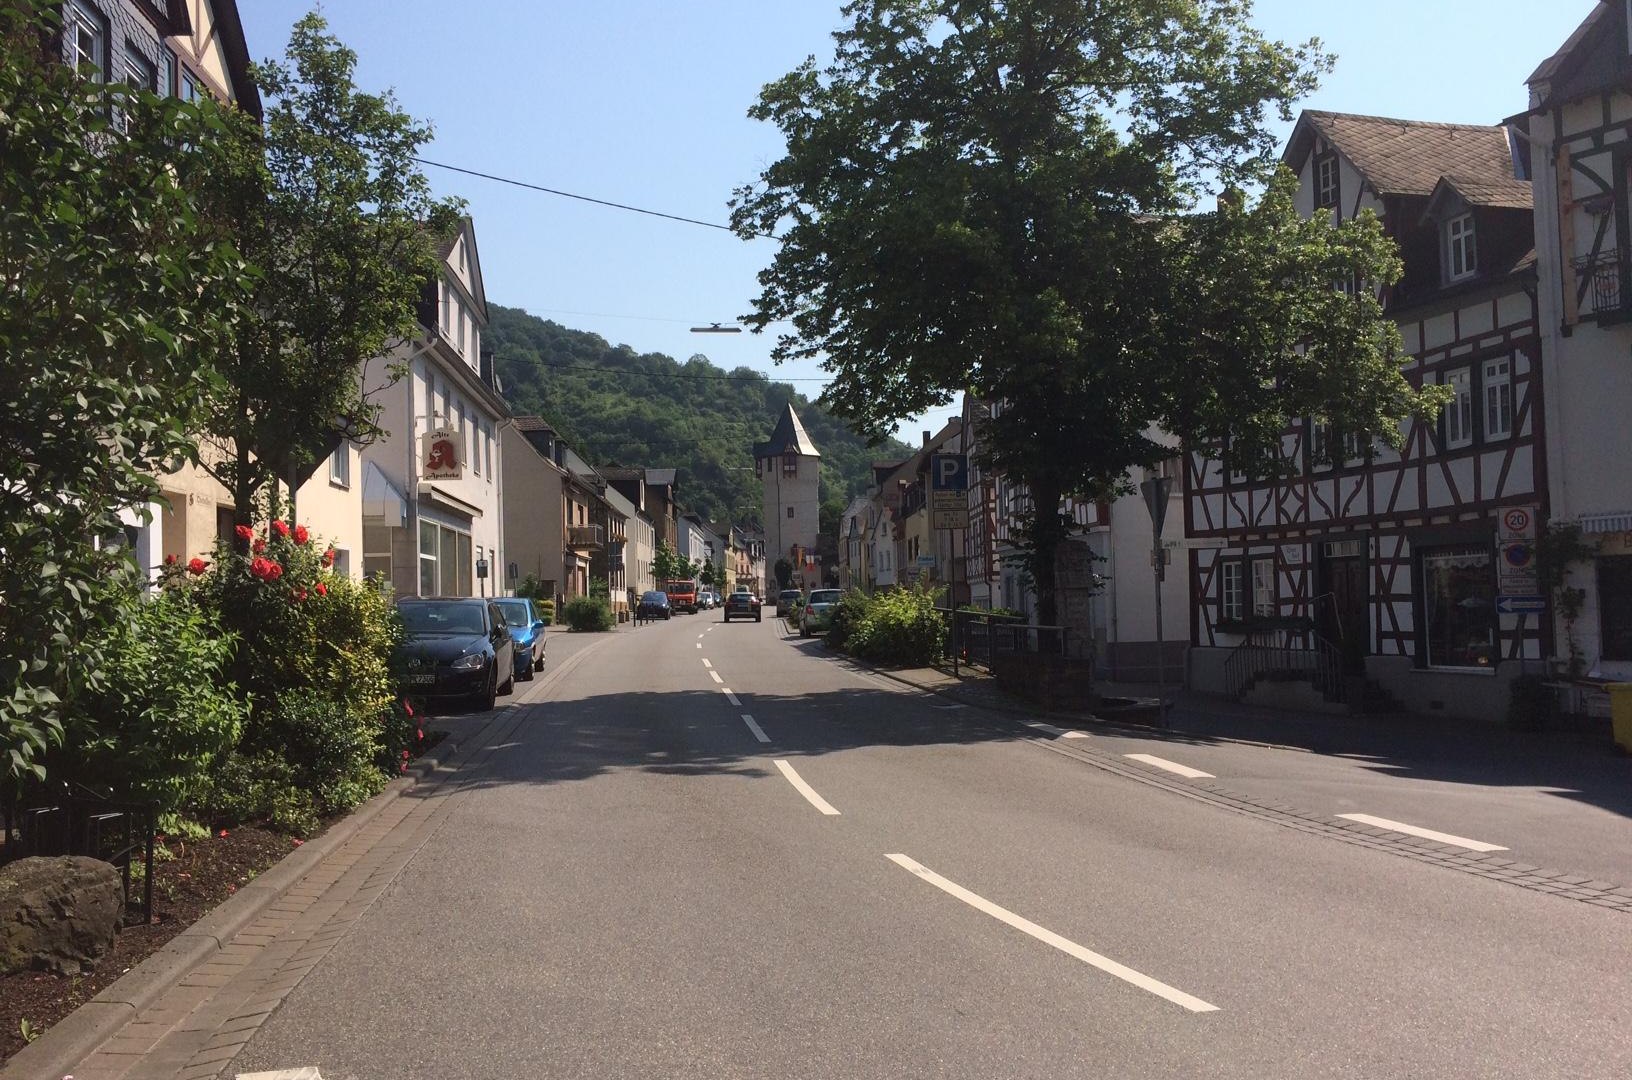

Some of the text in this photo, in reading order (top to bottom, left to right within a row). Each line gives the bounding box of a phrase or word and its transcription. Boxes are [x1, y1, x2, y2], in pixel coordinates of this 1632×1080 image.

[431, 431, 450, 439] Alte
[425, 472, 460, 480] Apotheke
[940, 459, 959, 486] P
[1510, 514, 1524, 525] 20
